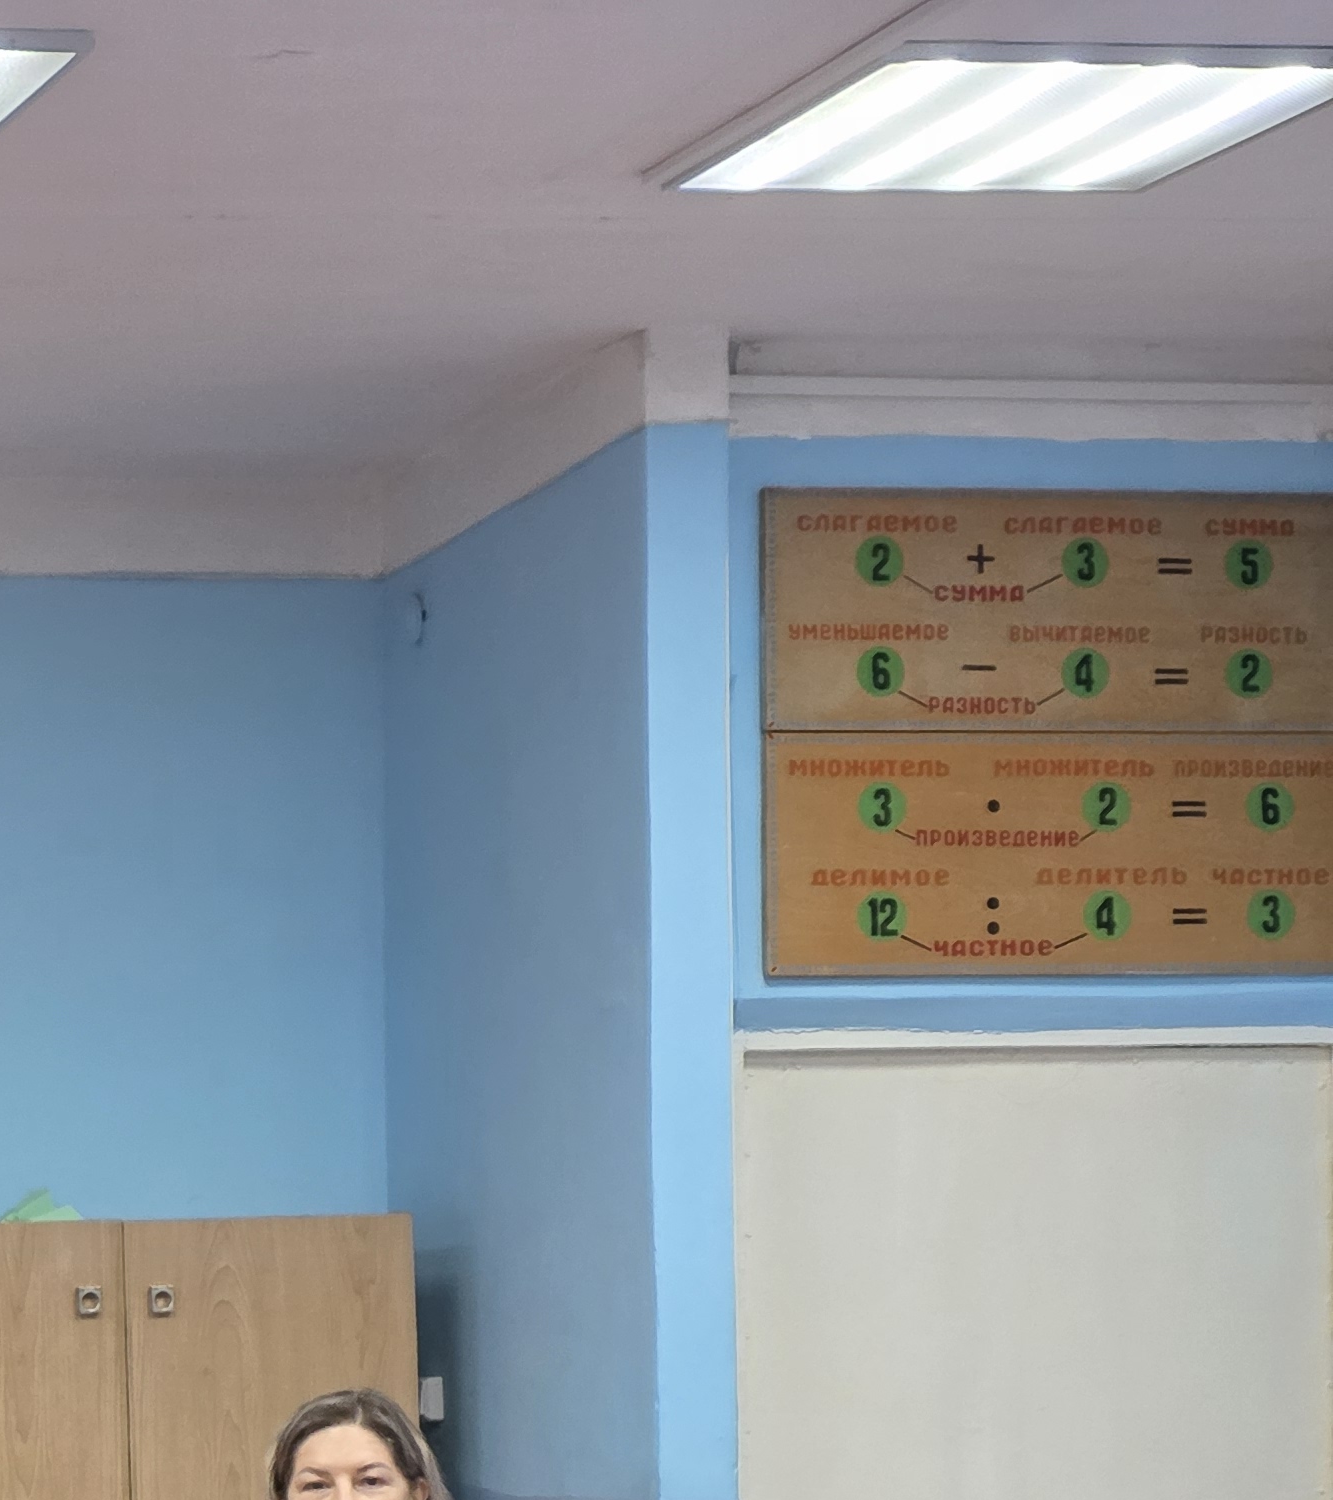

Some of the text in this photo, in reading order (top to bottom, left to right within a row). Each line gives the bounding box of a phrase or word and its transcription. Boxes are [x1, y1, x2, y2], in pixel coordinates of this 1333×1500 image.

[872, 543, 890, 581] 2
[1077, 542, 1095, 581] 3
[1241, 547, 1259, 585] 5
[871, 652, 890, 690] 6
[1074, 654, 1094, 692] 4
[1241, 654, 1259, 692] 2
[788, 758, 950, 777] множитель
[994, 758, 1155, 777] множитель
[873, 788, 892, 827] 3
[1099, 787, 1117, 826] 2
[1261, 787, 1280, 825] 6
[811, 867, 1330, 886] делимое делитель частное
[868, 898, 898, 937] 12
[1097, 897, 1116, 936] 4
[1262, 896, 1280, 934] 3
